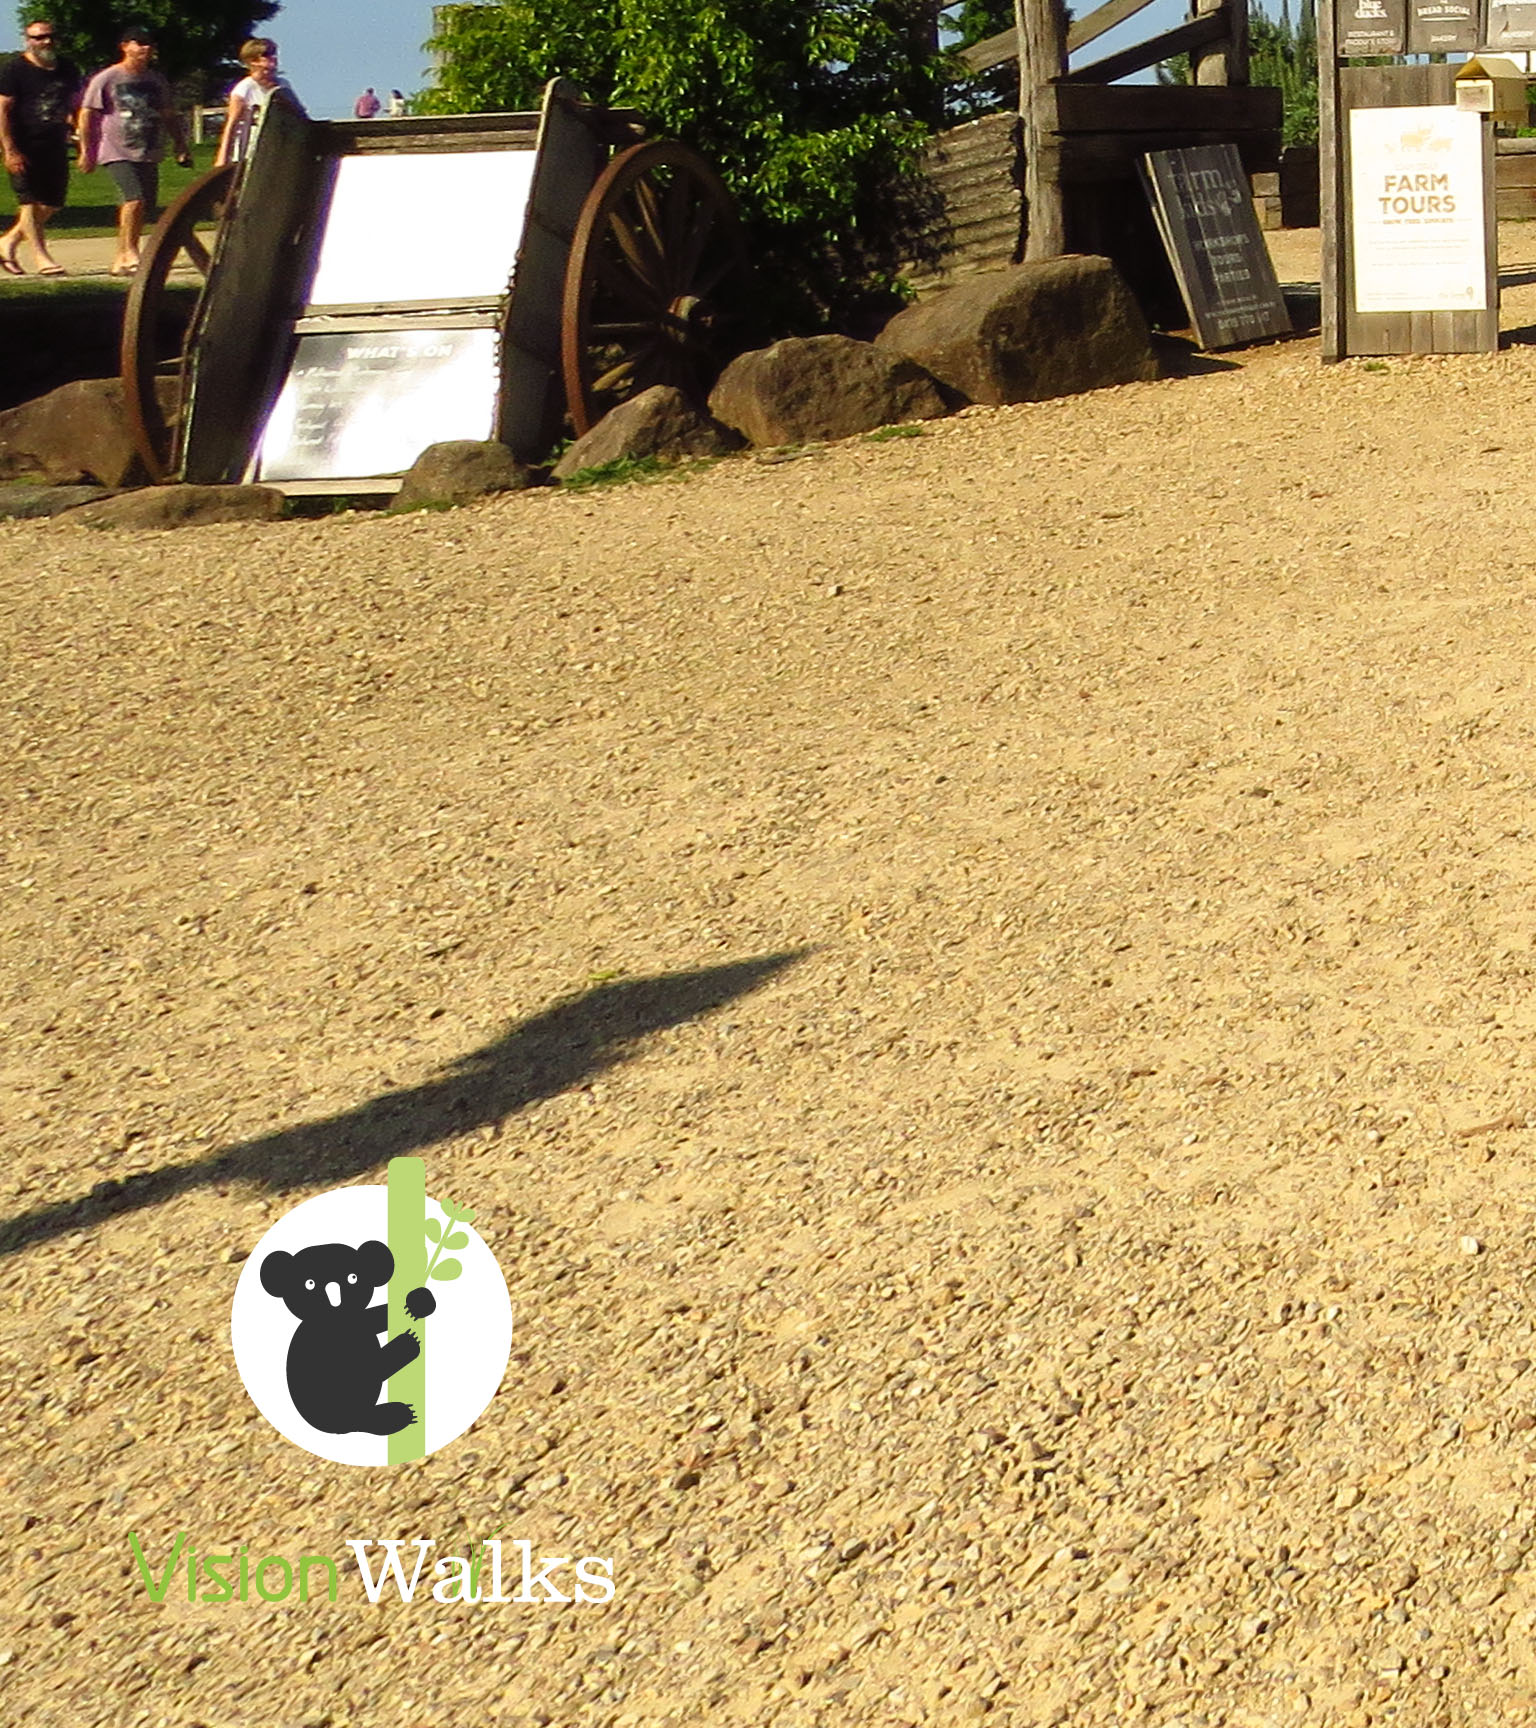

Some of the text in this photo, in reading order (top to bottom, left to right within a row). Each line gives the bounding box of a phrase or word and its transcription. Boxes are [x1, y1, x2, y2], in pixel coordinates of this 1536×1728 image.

[1384, 173, 1448, 192] FARM
[1378, 195, 1456, 214] TOURS
[347, 344, 453, 360] WHAT'S ON
